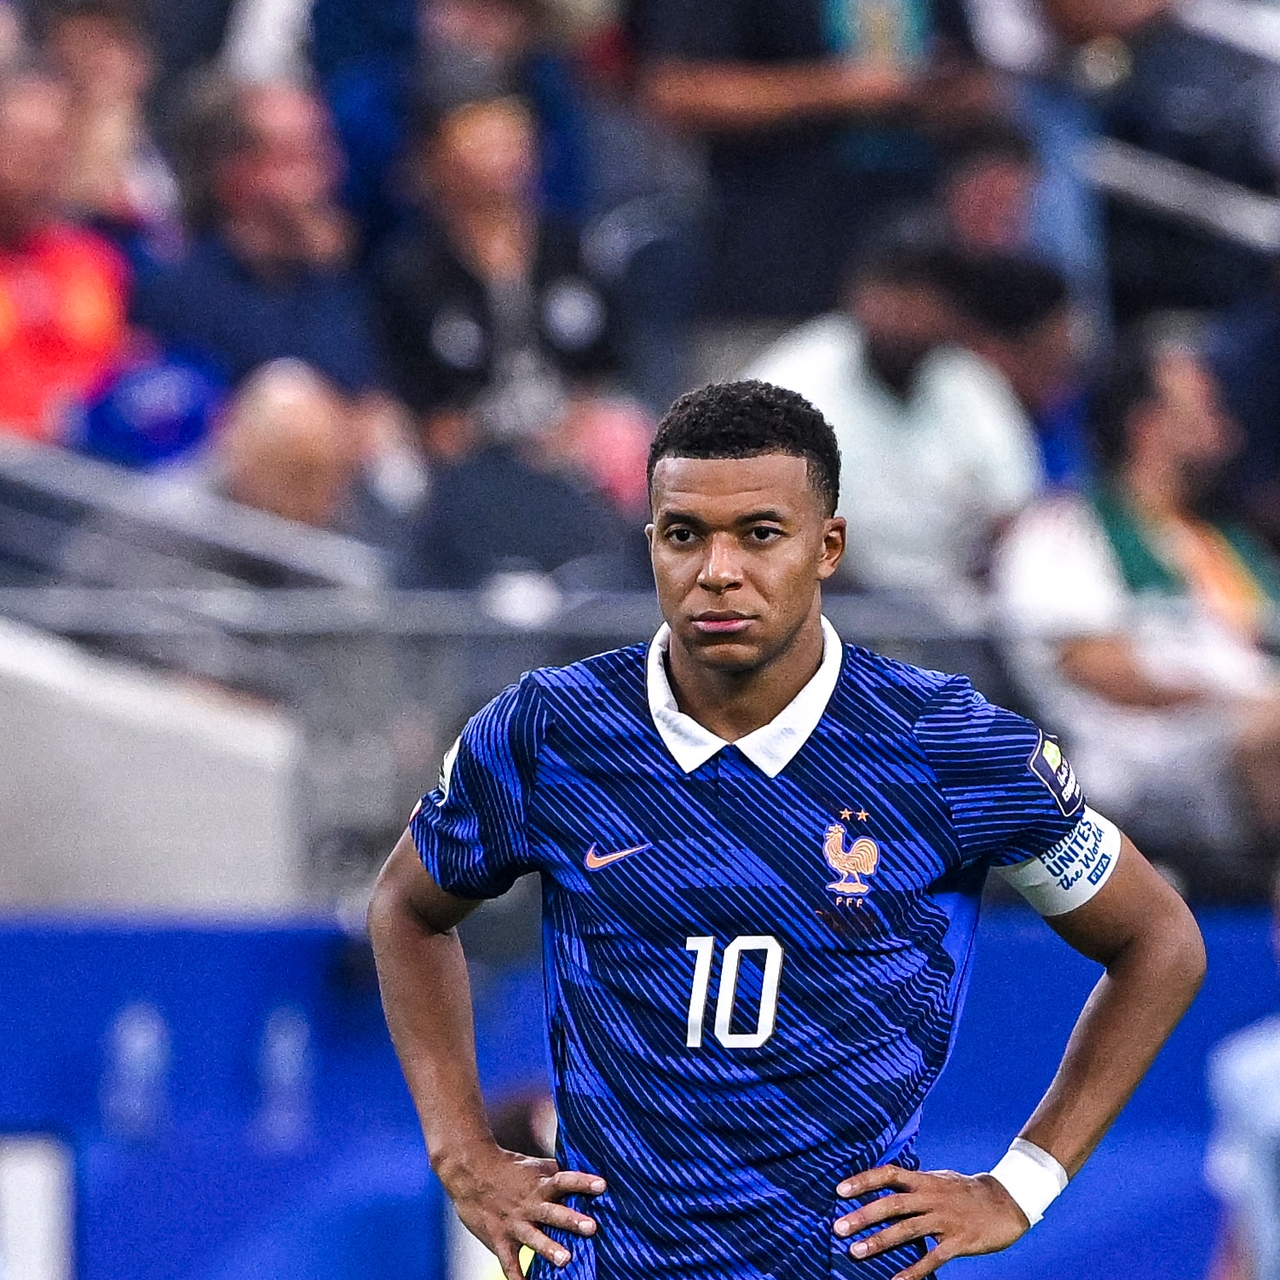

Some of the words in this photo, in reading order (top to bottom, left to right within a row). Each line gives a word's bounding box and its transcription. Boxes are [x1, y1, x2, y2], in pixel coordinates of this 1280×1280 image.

[1046, 820, 1092, 877] UNITES
[1056, 869, 1083, 890] the
[1078, 822, 1105, 869] World
[1089, 856, 1110, 883] FIFA
[686, 935, 783, 1048] 10
